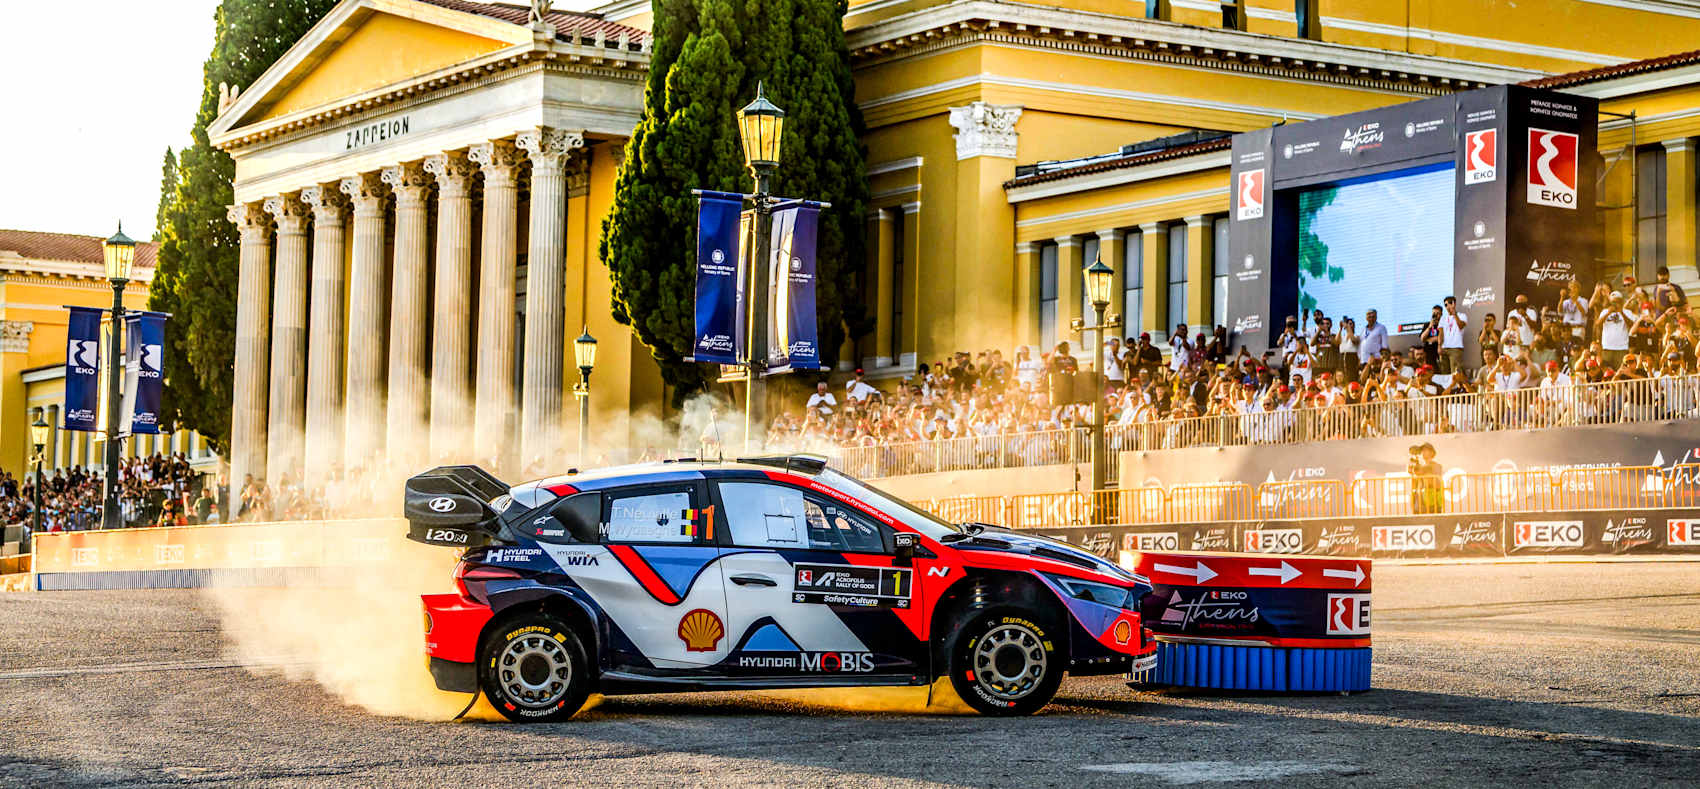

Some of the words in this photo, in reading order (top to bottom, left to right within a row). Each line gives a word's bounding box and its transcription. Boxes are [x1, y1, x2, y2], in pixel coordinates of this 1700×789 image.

[1474, 169, 1494, 180] EKO
[1541, 190, 1573, 204] EKO
[1244, 207, 1262, 217] EKO
[75, 367, 95, 376] EKO
[1305, 467, 1326, 478] EKO
[1023, 494, 1084, 526] EKO
[702, 504, 715, 540] 1
[1262, 532, 1301, 549] EKO
[1391, 529, 1434, 547] EKO
[1535, 524, 1582, 543] EKO
[1141, 535, 1177, 550] EKO
[893, 571, 901, 596] 1
[823, 595, 879, 605] SafetyCulture
[1220, 591, 1248, 601] EKO
[1160, 589, 1260, 631] Athens
[740, 657, 796, 668] HYUNDAI
[800, 652, 876, 672] MOBIS
